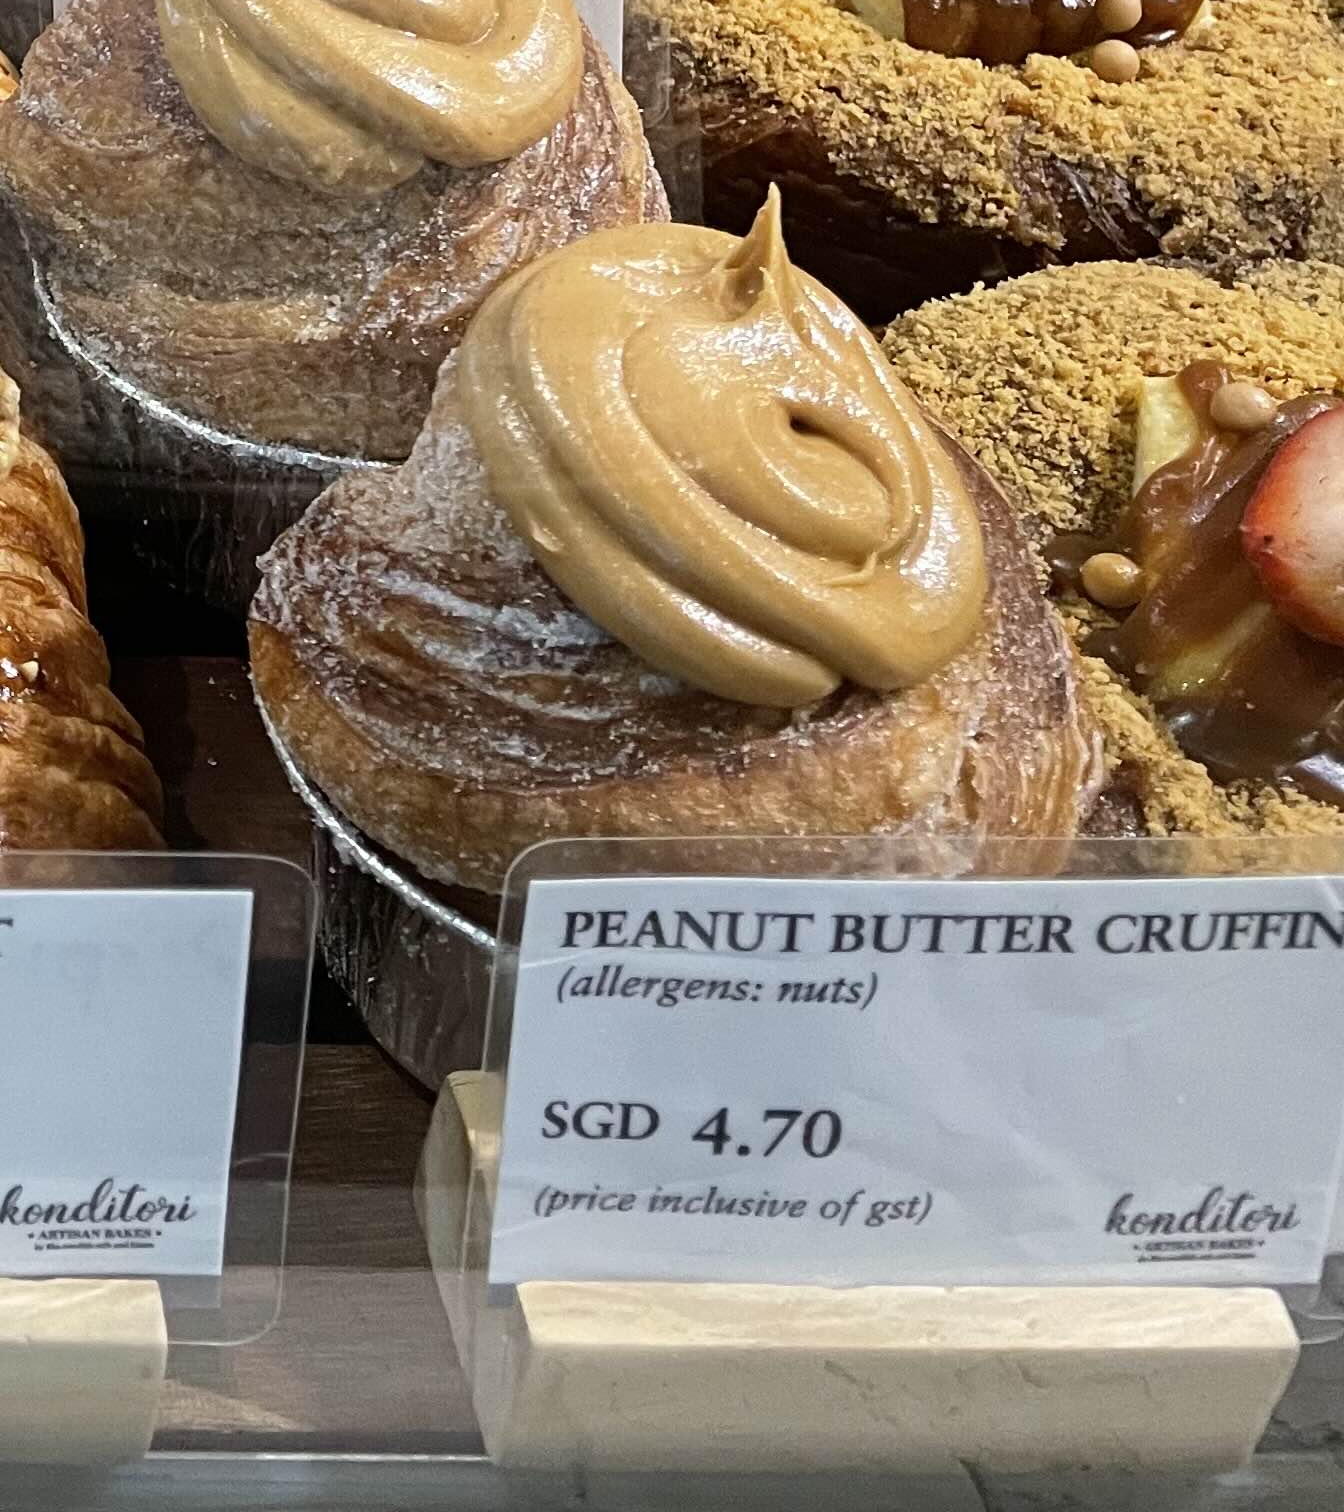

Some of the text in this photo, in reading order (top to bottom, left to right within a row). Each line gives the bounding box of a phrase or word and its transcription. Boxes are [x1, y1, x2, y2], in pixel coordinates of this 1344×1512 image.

[561, 910, 816, 954] PEANUT
[829, 914, 1074, 956] BUTTER
[557, 966, 879, 1010] (allergens: nuts)
[541, 1102, 843, 1158] SGD 4.70
[534, 1185, 932, 1226] (price inclusive of gst)
[1104, 1185, 1301, 1235] konditori
[38, 1229, 100, 1240] ARTISAN
